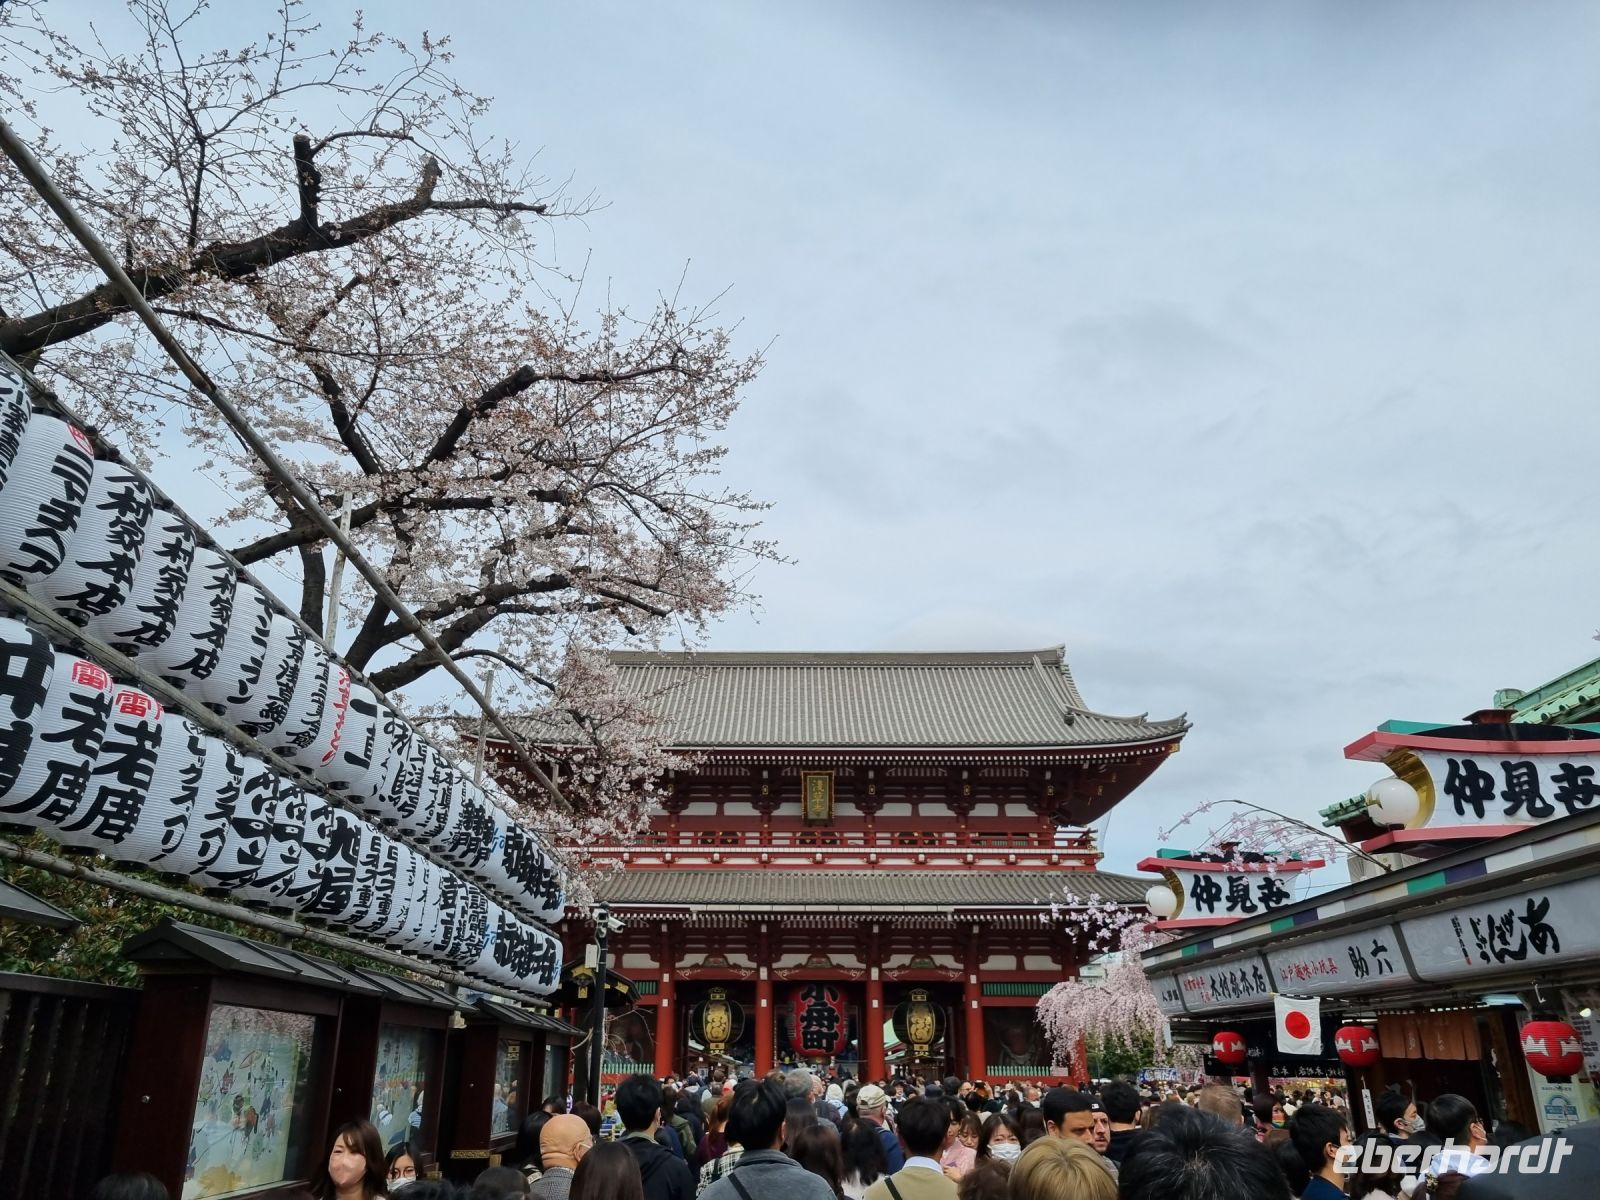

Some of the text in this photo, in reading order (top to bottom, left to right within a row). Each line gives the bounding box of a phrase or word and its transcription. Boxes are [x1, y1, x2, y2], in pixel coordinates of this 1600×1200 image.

[1444, 758, 1600, 819] 仲見世
[1190, 874, 1291, 914] 仲見世
[1348, 938, 1393, 979] 助六
[1210, 965, 1267, 1002] 木村家本店
[800, 984, 840, 1054] 小舟町
